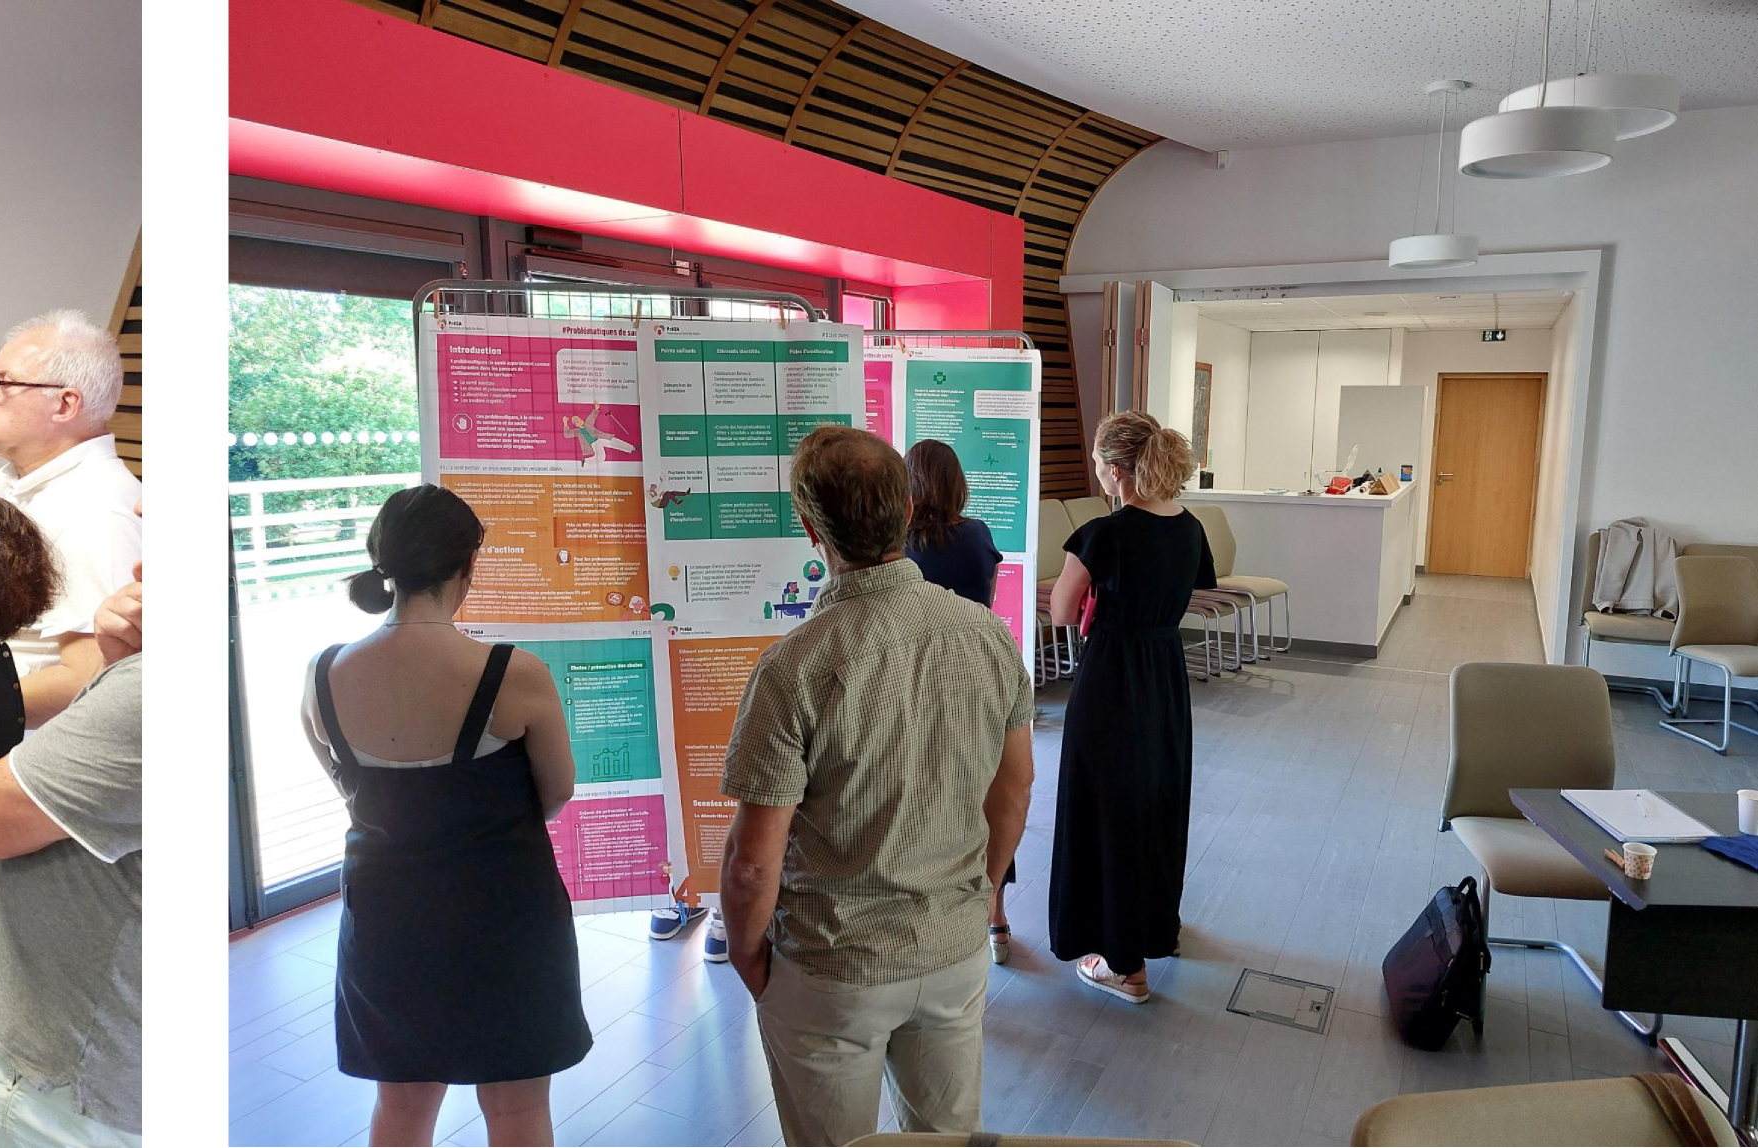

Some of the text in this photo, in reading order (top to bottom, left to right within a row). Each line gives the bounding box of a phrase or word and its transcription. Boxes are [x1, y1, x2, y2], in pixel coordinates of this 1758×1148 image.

[562, 327, 617, 336] #Problématiques
[449, 346, 502, 355] Introduction
[487, 546, 525, 554] d'actions
